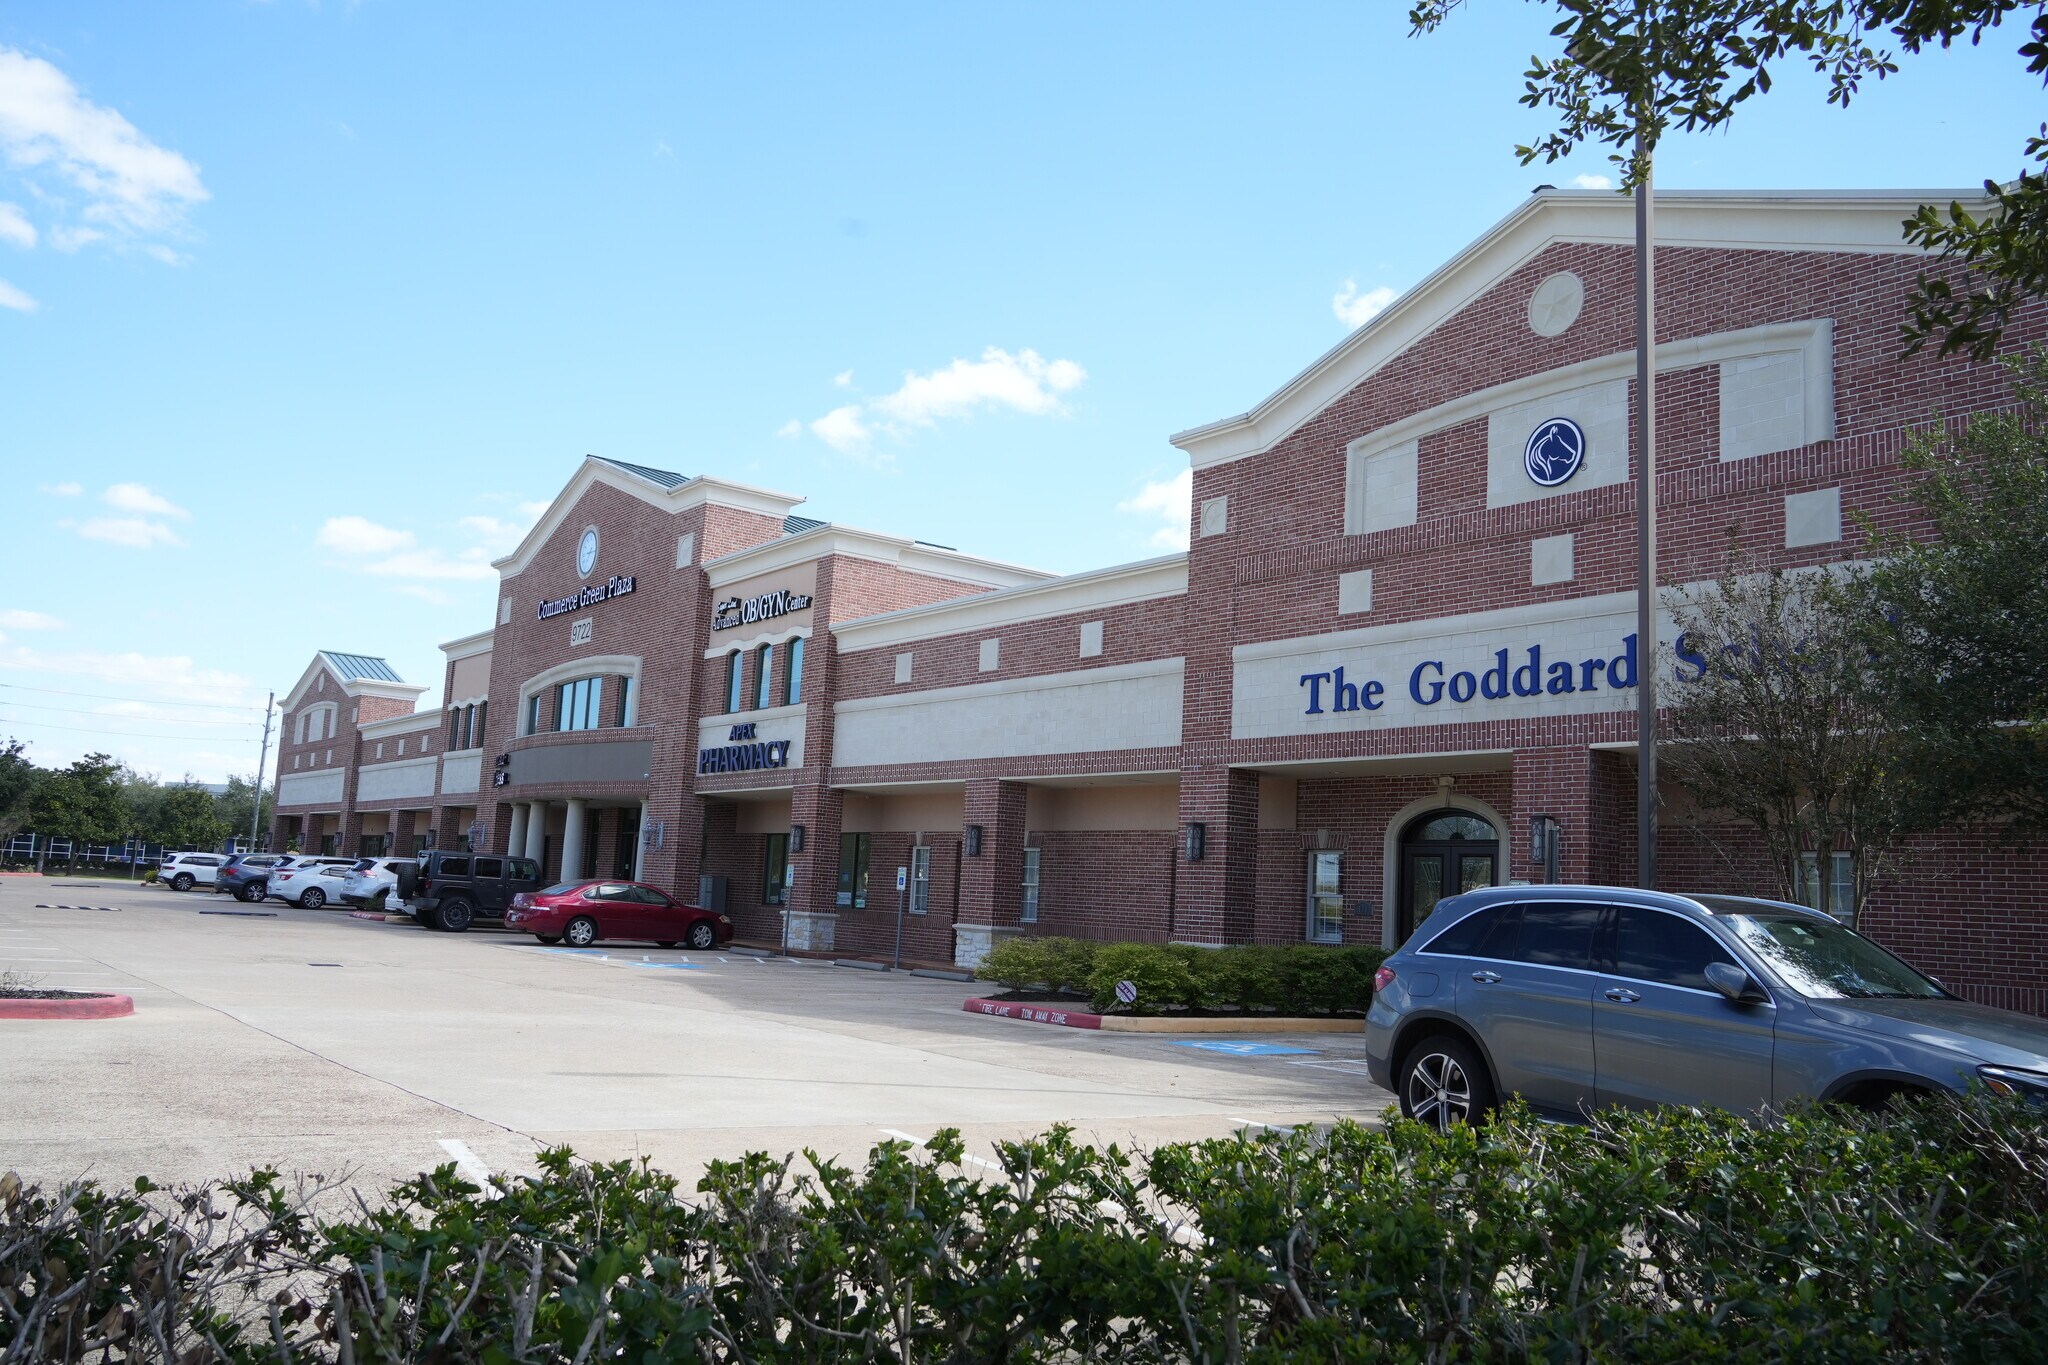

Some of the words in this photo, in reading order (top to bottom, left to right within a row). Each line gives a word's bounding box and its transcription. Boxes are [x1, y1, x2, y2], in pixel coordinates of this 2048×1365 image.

[537, 595, 578, 620] Commerce
[580, 585, 606, 607] Green
[607, 575, 633, 598] Plaza
[712, 610, 741, 631] Advanced
[742, 589, 786, 624] OB/GYN
[785, 595, 809, 612] Center
[571, 622, 591, 642] 9722
[1300, 665, 1384, 715] The
[1409, 632, 1640, 706] Goddard
[728, 722, 756, 741] APEX
[699, 740, 791, 774] PHARMACY
[981, 1003, 995, 1015] FIRE
[995, 1005, 1010, 1017] LANE
[1021, 1008, 1033, 1020] TOW
[1034, 1010, 1049, 1022] AWAY
[1050, 1012, 1068, 1024] ZONE
